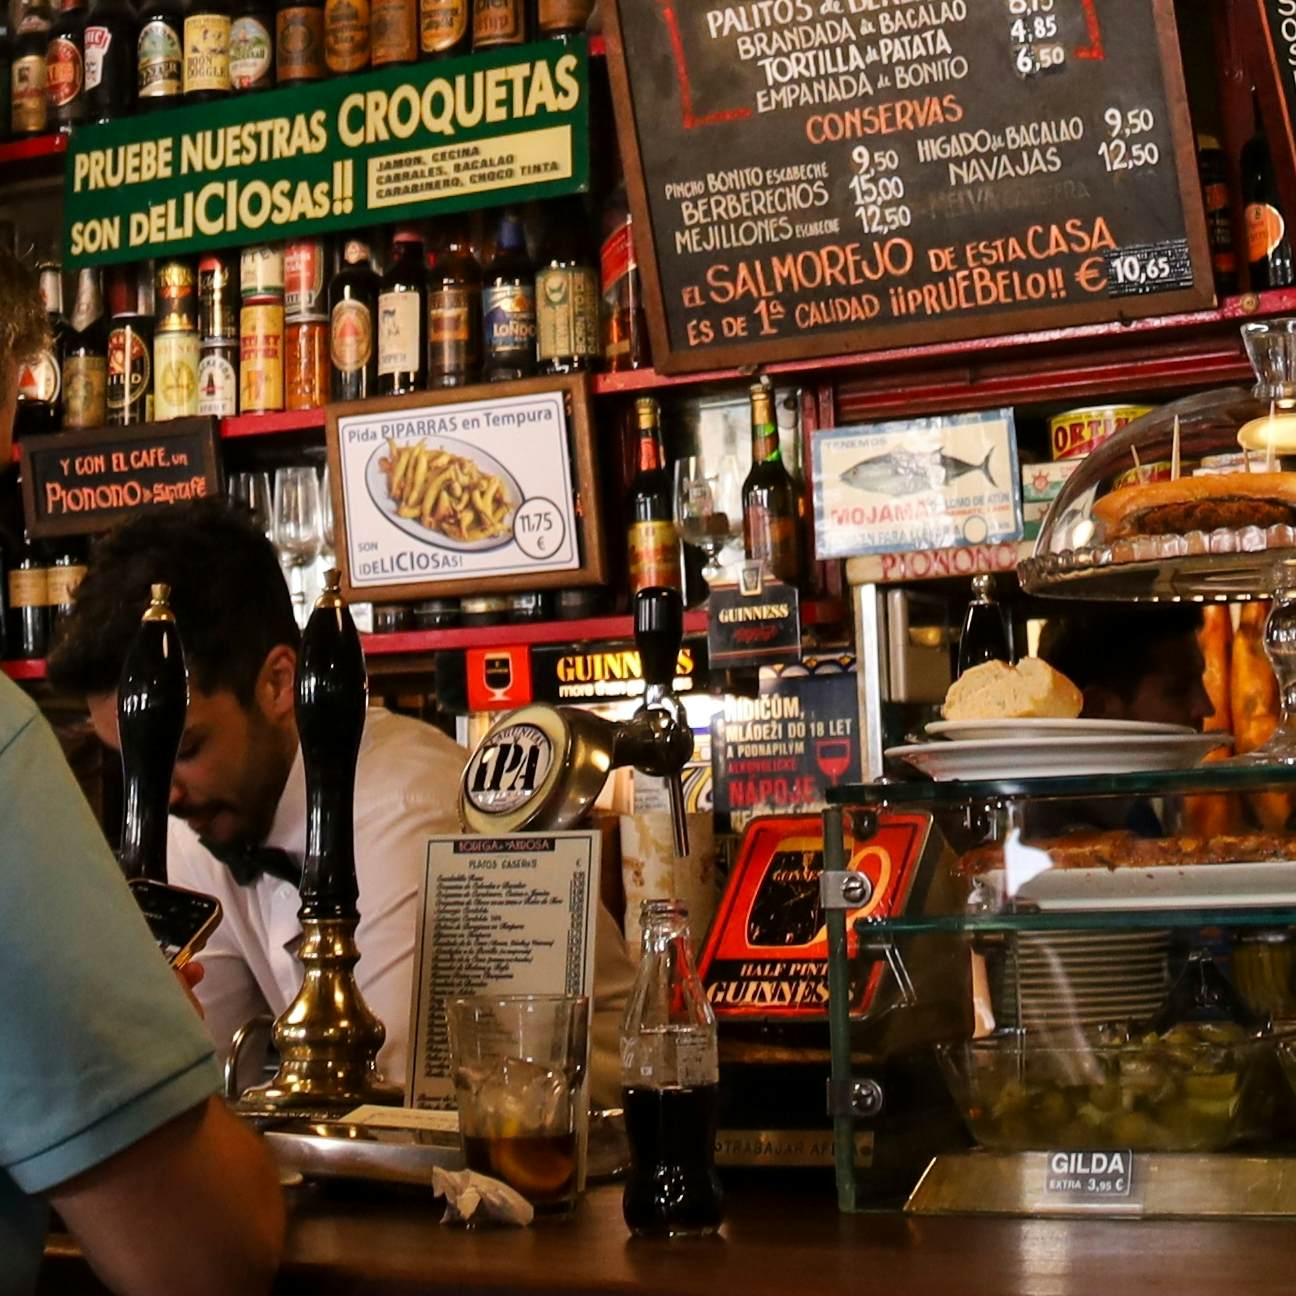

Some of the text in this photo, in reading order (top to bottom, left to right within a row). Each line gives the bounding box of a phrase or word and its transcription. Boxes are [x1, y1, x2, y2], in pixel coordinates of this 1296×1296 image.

[73, 53, 581, 193] PRUEBE NUESTRAS CROQUETAS
[805, 94, 963, 144] CONSERVAS
[948, 138, 1159, 186] NAVAJAS 12,50
[70, 214, 121, 257] SON
[706, 237, 914, 303] SALMOREJO
[927, 246, 957, 273] DE
[965, 237, 1027, 269] ESTA
[1026, 216, 1120, 260] CASA
[687, 319, 715, 347] ES
[721, 316, 748, 338] DE
[794, 293, 881, 329] CALIDAD
[1074, 256, 1108, 292] €
[1111, 253, 1170, 284] 10,65
[347, 406, 553, 444] Pida PIPARRAS en Tempura
[59, 458, 71, 476] Y
[75, 454, 106, 476] CON
[111, 452, 129, 473] EL
[718, 603, 790, 624] GUINNESS
[787, 721, 806, 739] DO
[810, 720, 825, 738] 18
[829, 718, 853, 736] LET
[740, 962, 788, 978] HALF
[1050, 1150, 1125, 1176] GILDA
[1049, 1178, 1083, 1192] EXTRA
[1114, 1177, 1125, 1192] €
